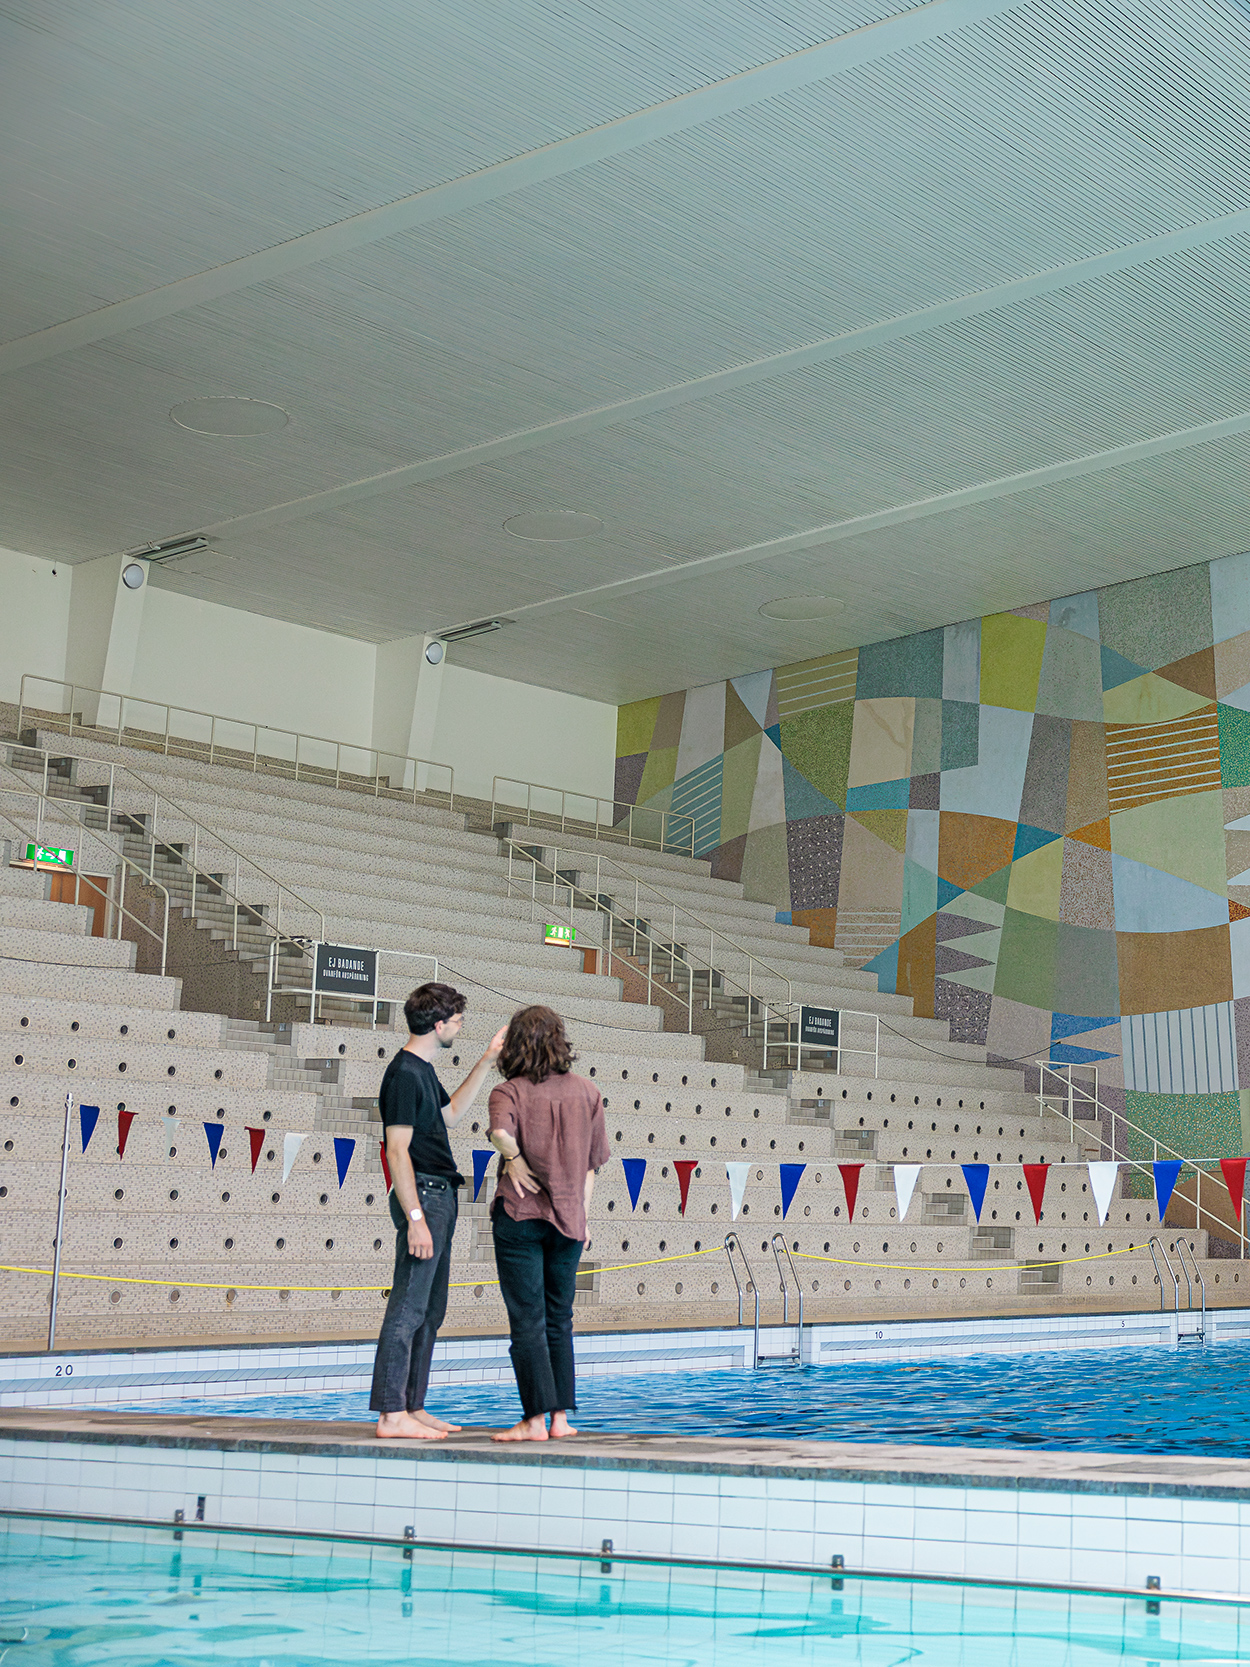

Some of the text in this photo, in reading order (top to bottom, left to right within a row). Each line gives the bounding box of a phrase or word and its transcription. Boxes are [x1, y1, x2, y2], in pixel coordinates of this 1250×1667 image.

[328, 956, 364, 971] EJ BADANDE
[875, 1330, 883, 1339] 10
[56, 1364, 72, 1376] 20
